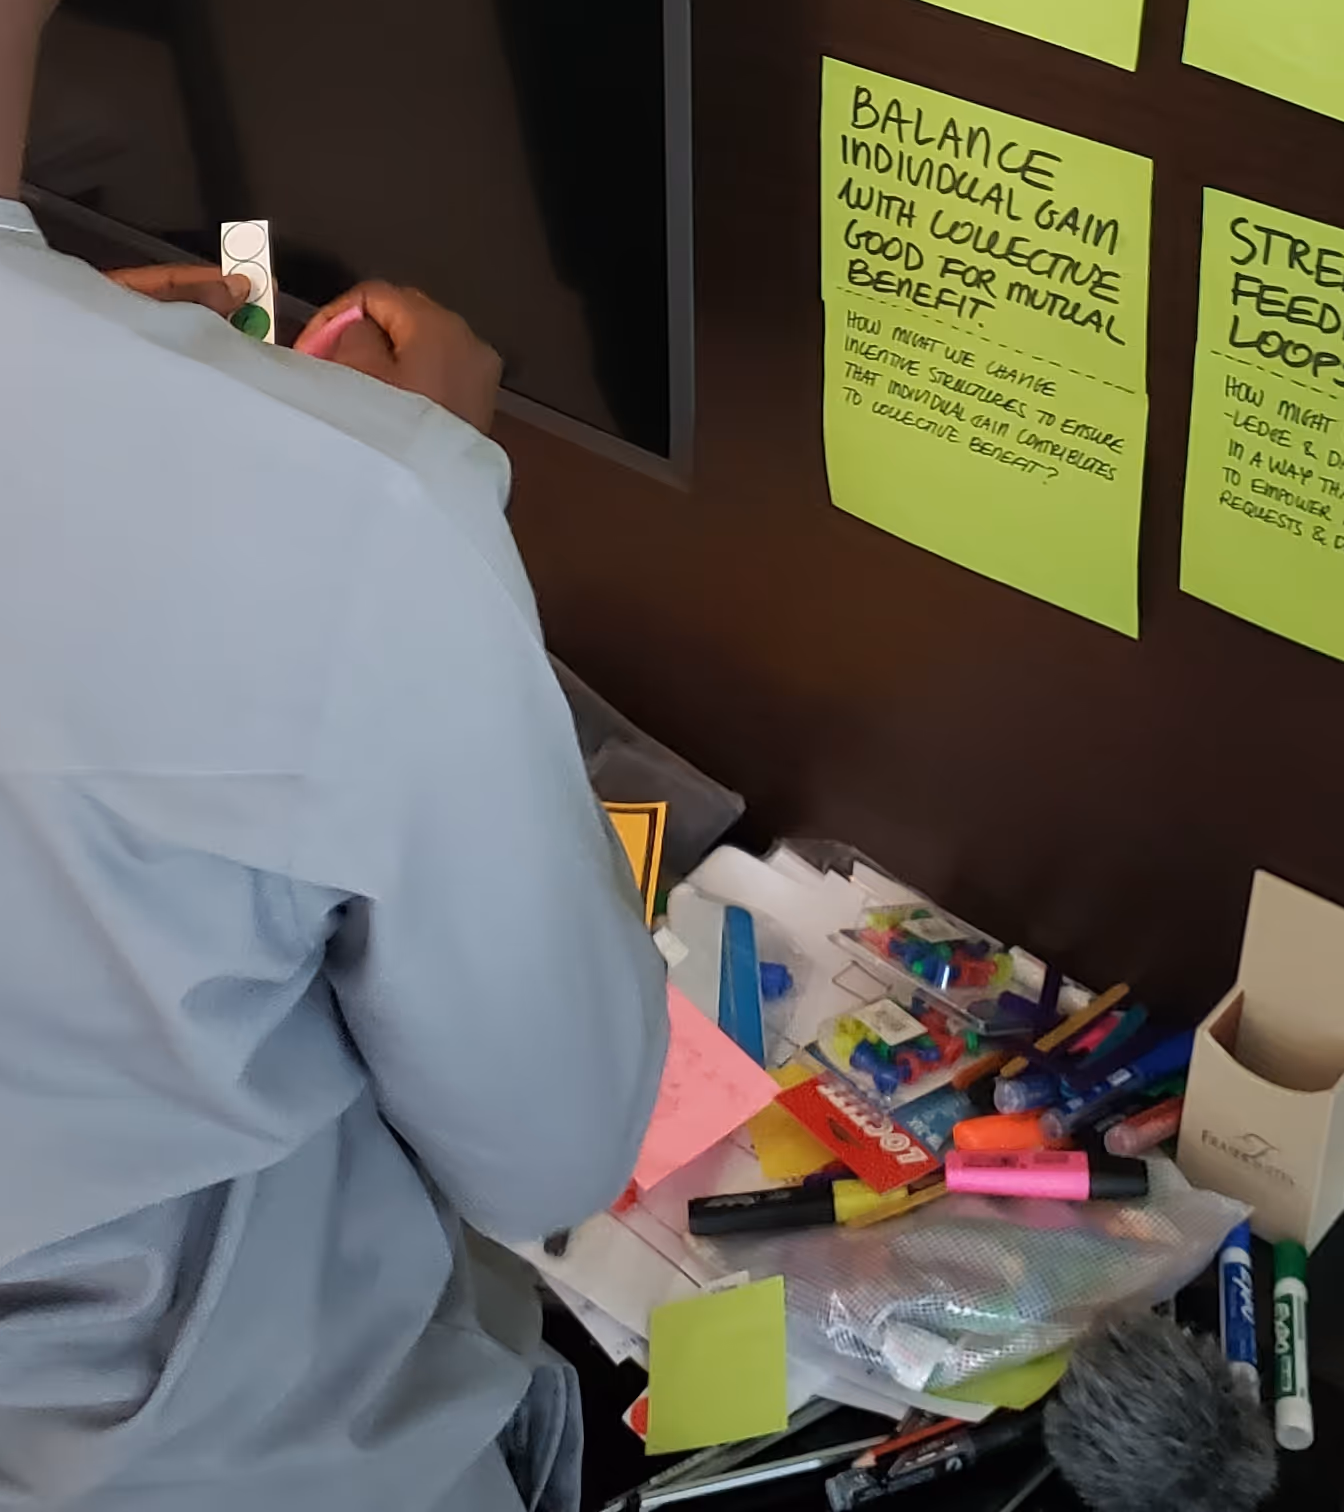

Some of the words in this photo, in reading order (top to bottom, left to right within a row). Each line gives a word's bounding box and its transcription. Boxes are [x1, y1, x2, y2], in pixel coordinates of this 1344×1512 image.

[840, 134, 1023, 222] INDIVIDUAL
[1034, 199, 1119, 255] GAIN
[851, 85, 1063, 193] BALANCE
[837, 177, 917, 228] WITH
[929, 209, 1121, 304] COLLECTIVE
[844, 219, 924, 271] GOOD
[937, 255, 997, 299] FOR
[1005, 281, 1125, 346] MUTUAL
[847, 309, 881, 336] HOW
[892, 327, 947, 353] MIGHT
[944, 346, 975, 368] WE
[986, 360, 1056, 397] CHANGE
[1225, 374, 1265, 408] HOW
[1277, 399, 1338, 434] MIGHT
